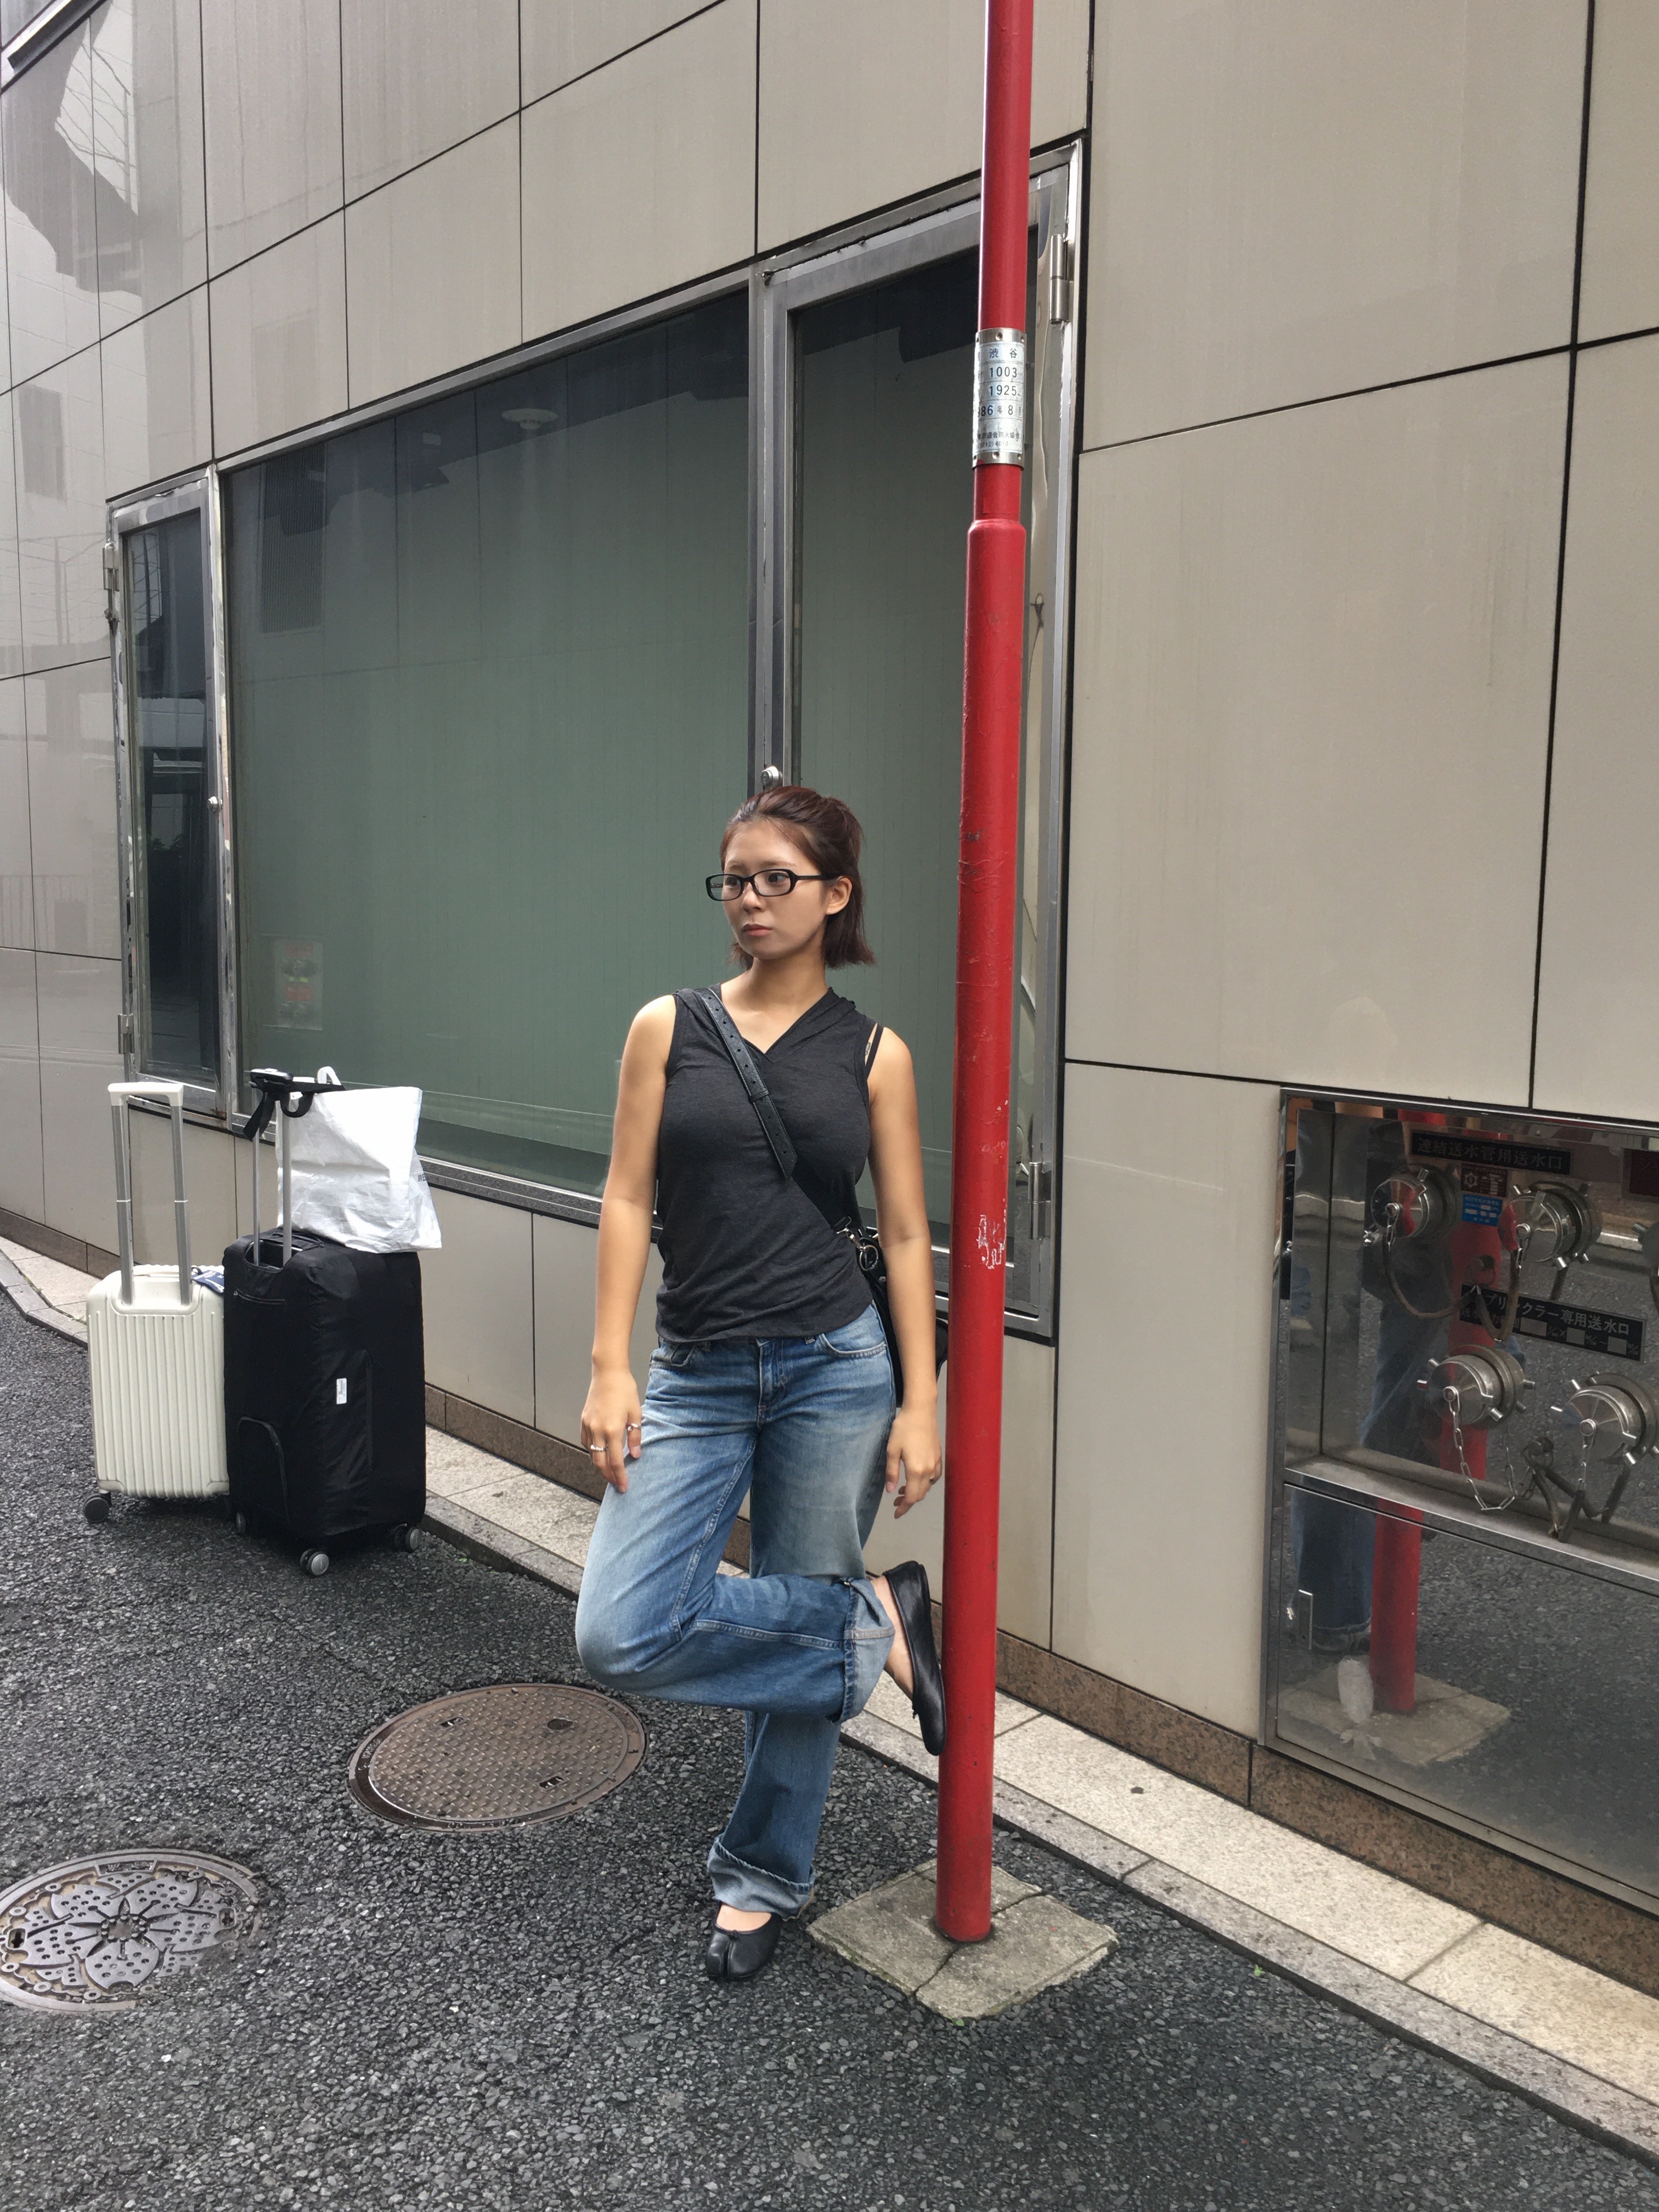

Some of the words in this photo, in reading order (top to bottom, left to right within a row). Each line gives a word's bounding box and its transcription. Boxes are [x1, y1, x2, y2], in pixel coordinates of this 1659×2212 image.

[989, 347, 1018, 358] 渋谷
[990, 366, 1017, 378] 1003
[990, 384, 1017, 397] 1925
[1418, 1138, 1563, 1170] 連結送水管用送水口
[1485, 1293, 1630, 1336] プリクラー専用送水口
